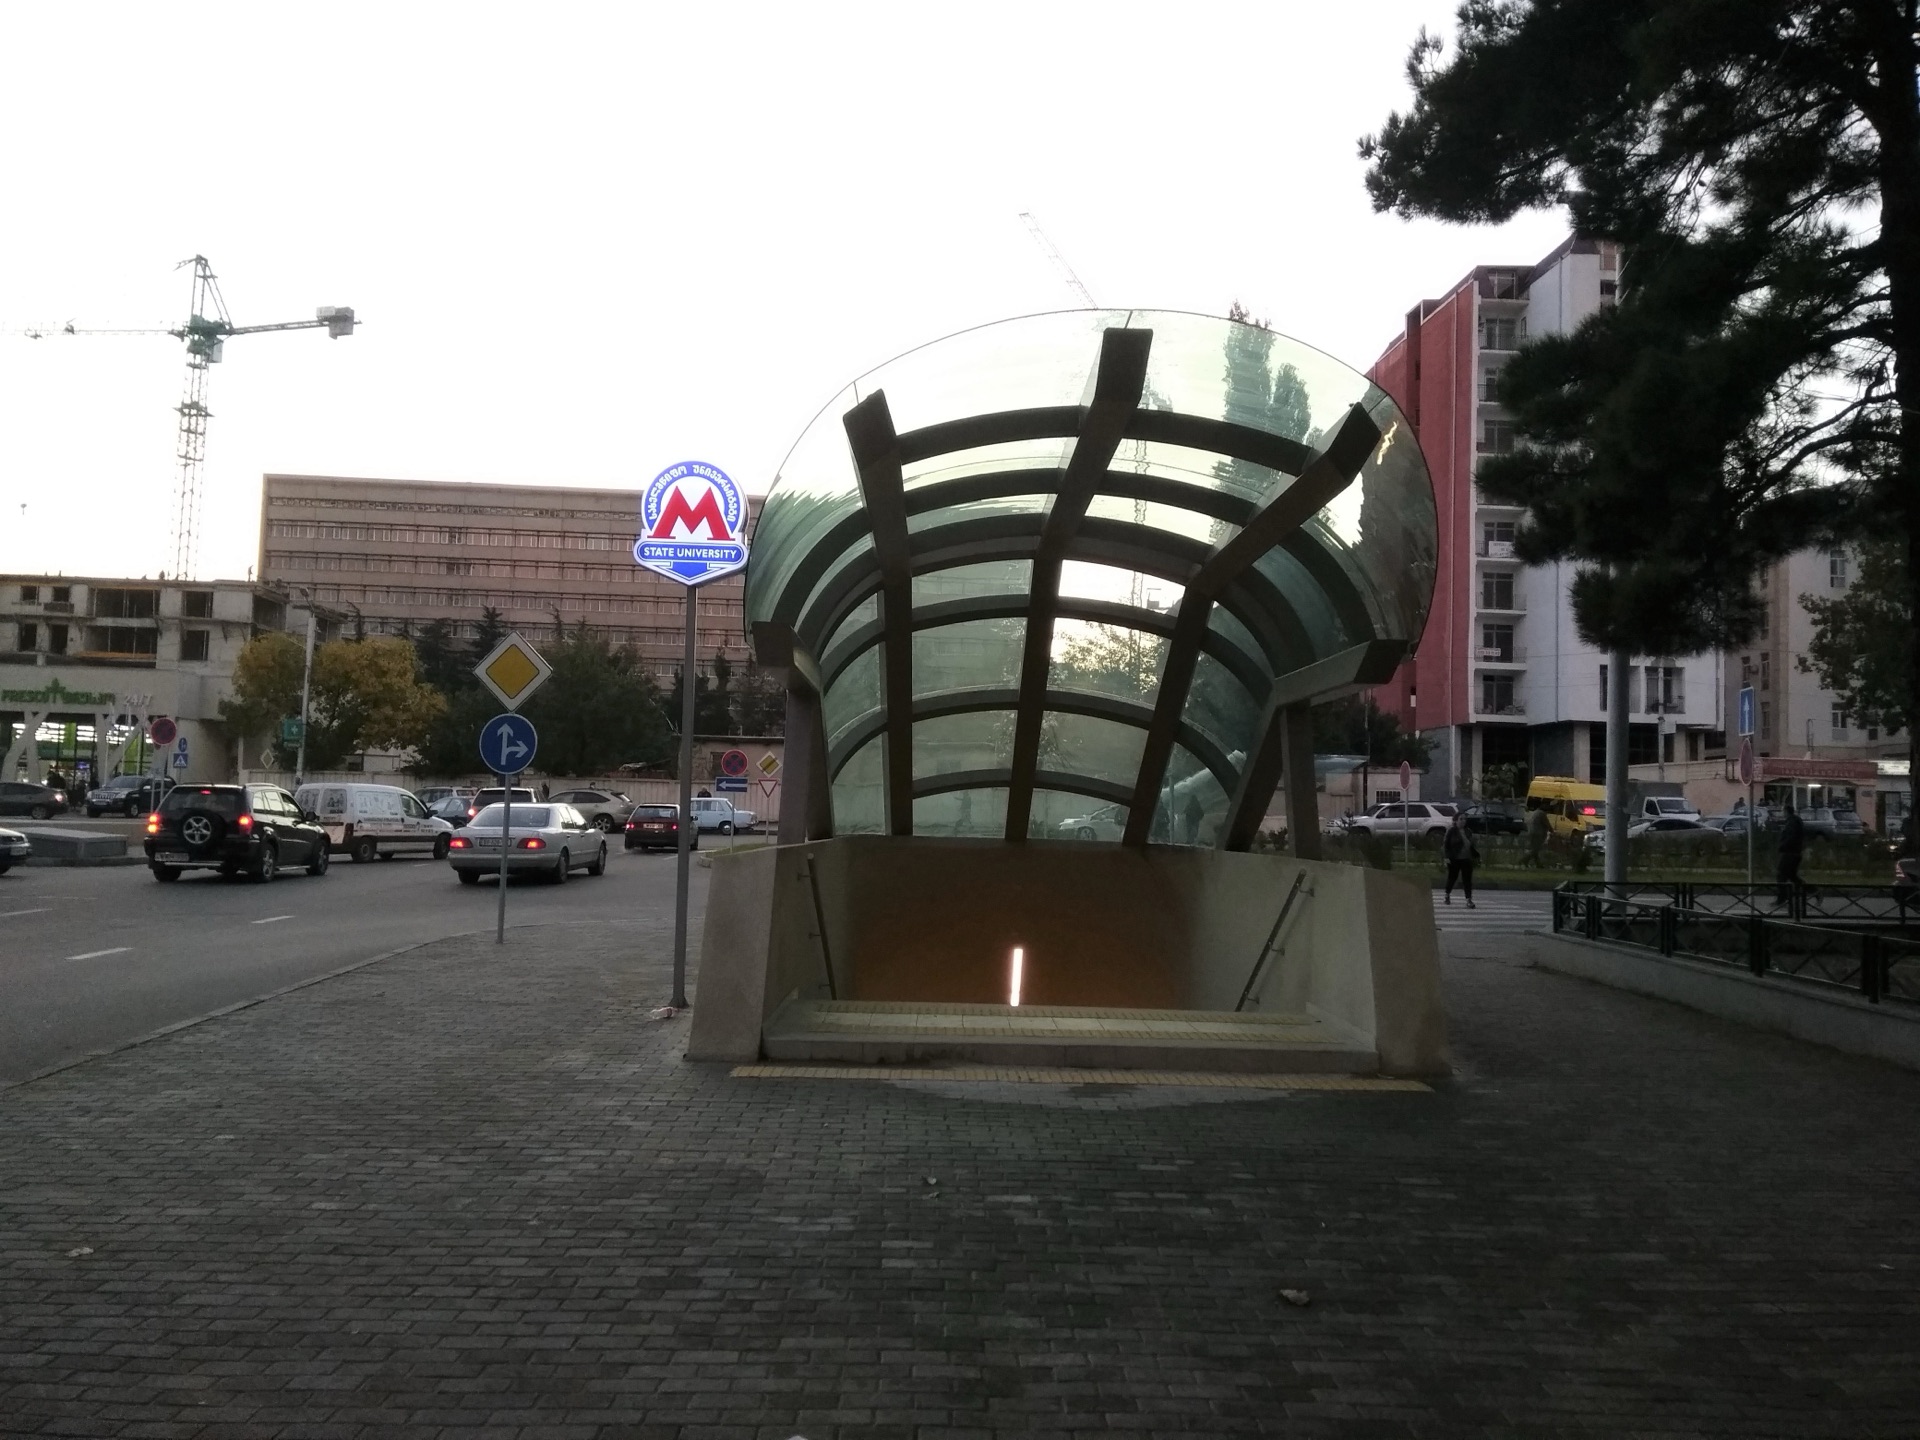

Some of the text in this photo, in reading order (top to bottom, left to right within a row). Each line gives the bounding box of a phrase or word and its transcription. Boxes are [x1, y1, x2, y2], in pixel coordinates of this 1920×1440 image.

[647, 485, 736, 541] M
[692, 464, 738, 522] უნივერსიტეტი
[644, 547, 737, 558] STATE UNIVERSITY
